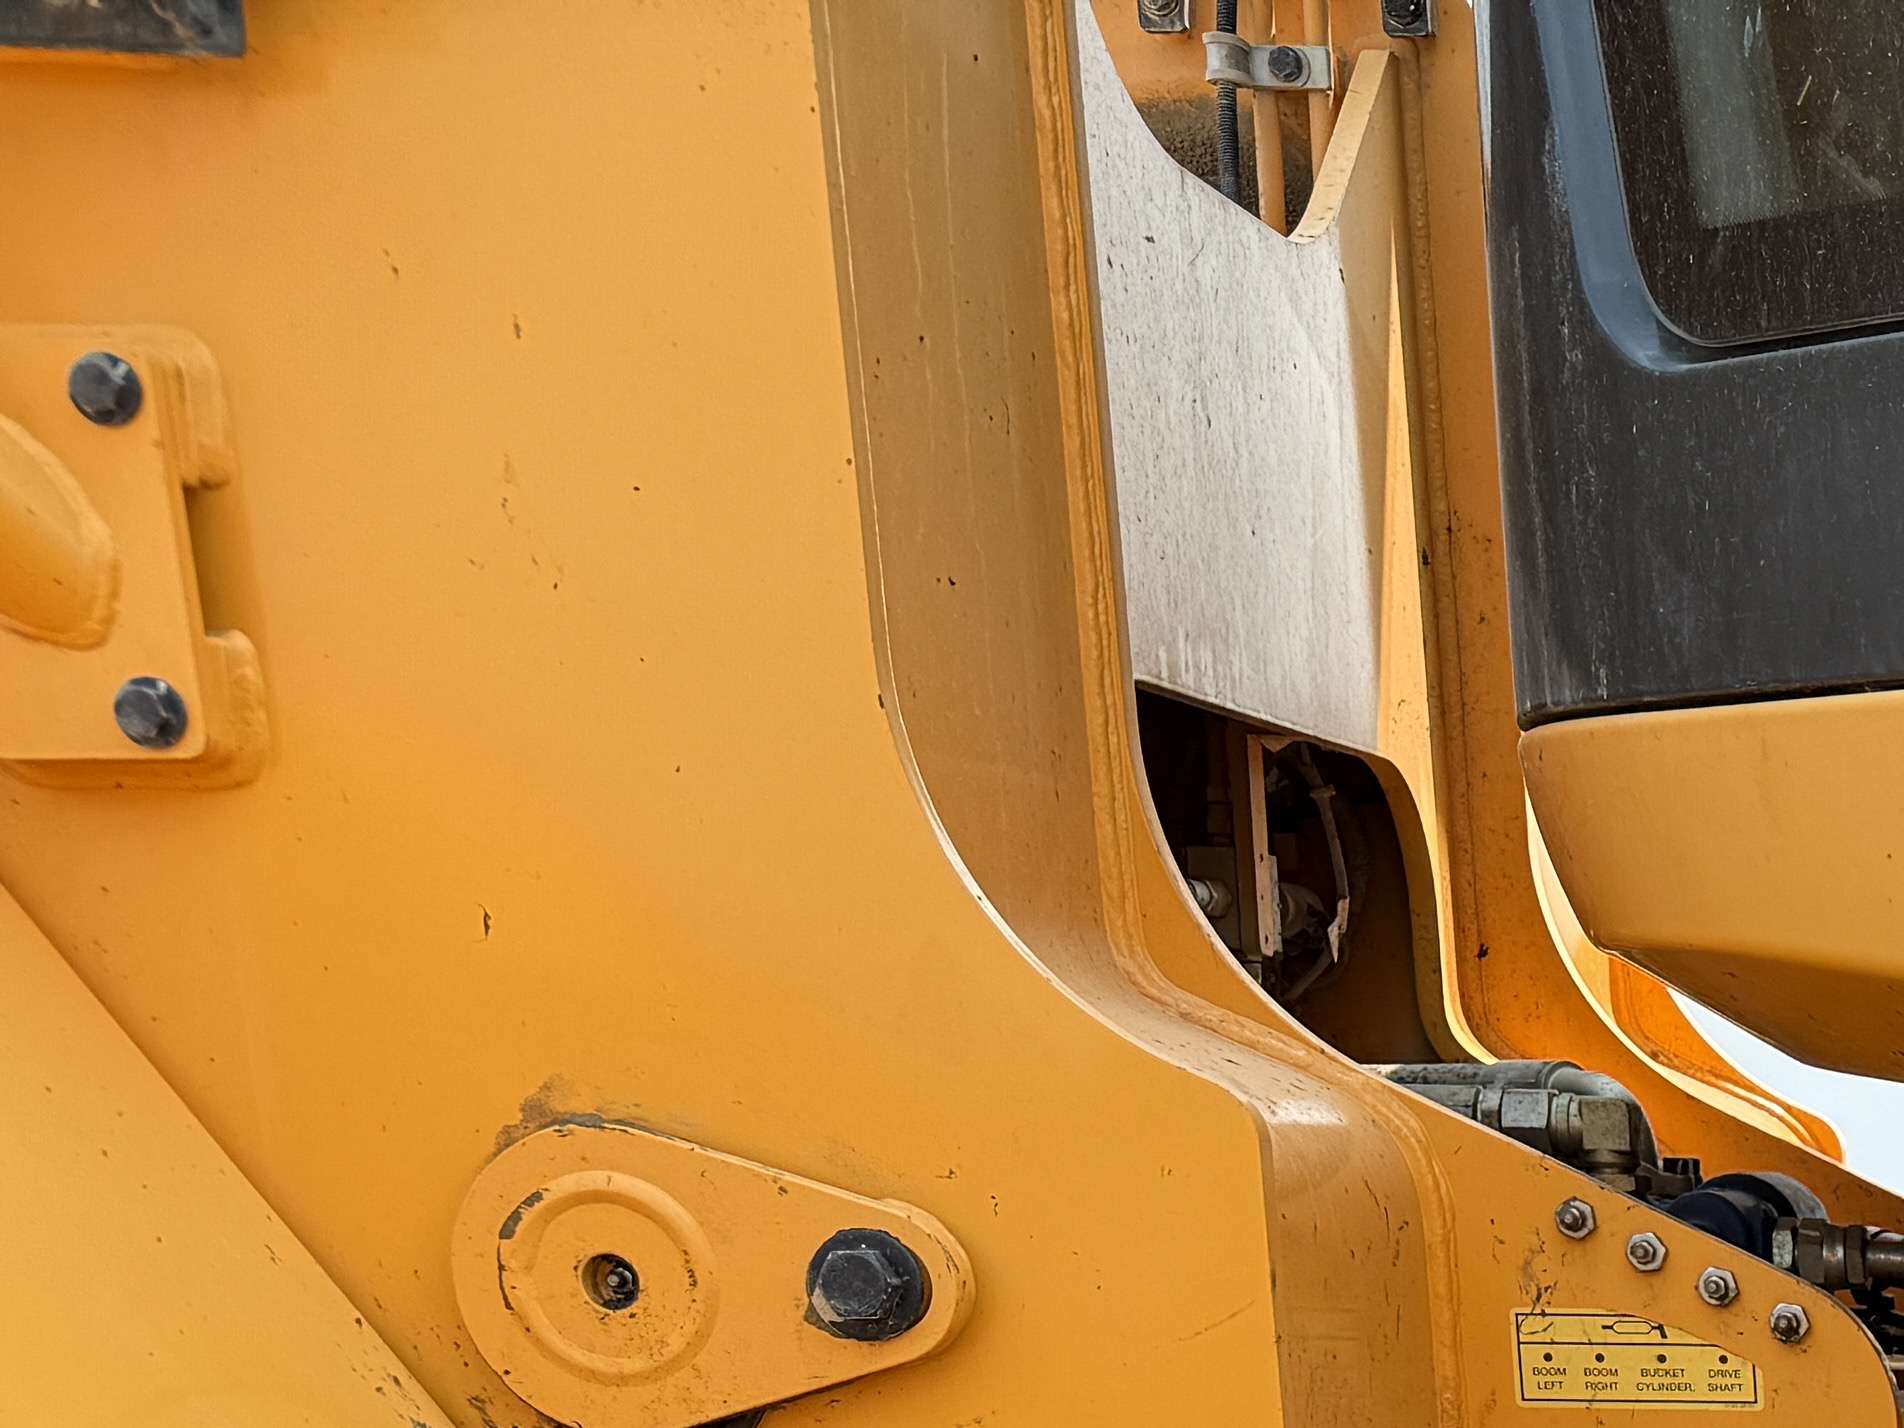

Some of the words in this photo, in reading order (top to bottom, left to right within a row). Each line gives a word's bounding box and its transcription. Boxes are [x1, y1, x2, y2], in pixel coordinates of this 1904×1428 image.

[1532, 1366, 1567, 1376] BOOM
[1583, 1367, 1619, 1377] BOOM
[1640, 1368, 1685, 1378] BUCKET
[1708, 1369, 1741, 1378] DRIVE
[1537, 1380, 1563, 1390] LEFT
[1584, 1381, 1619, 1391] RIGHT
[1708, 1382, 1743, 1392] SHAFT
